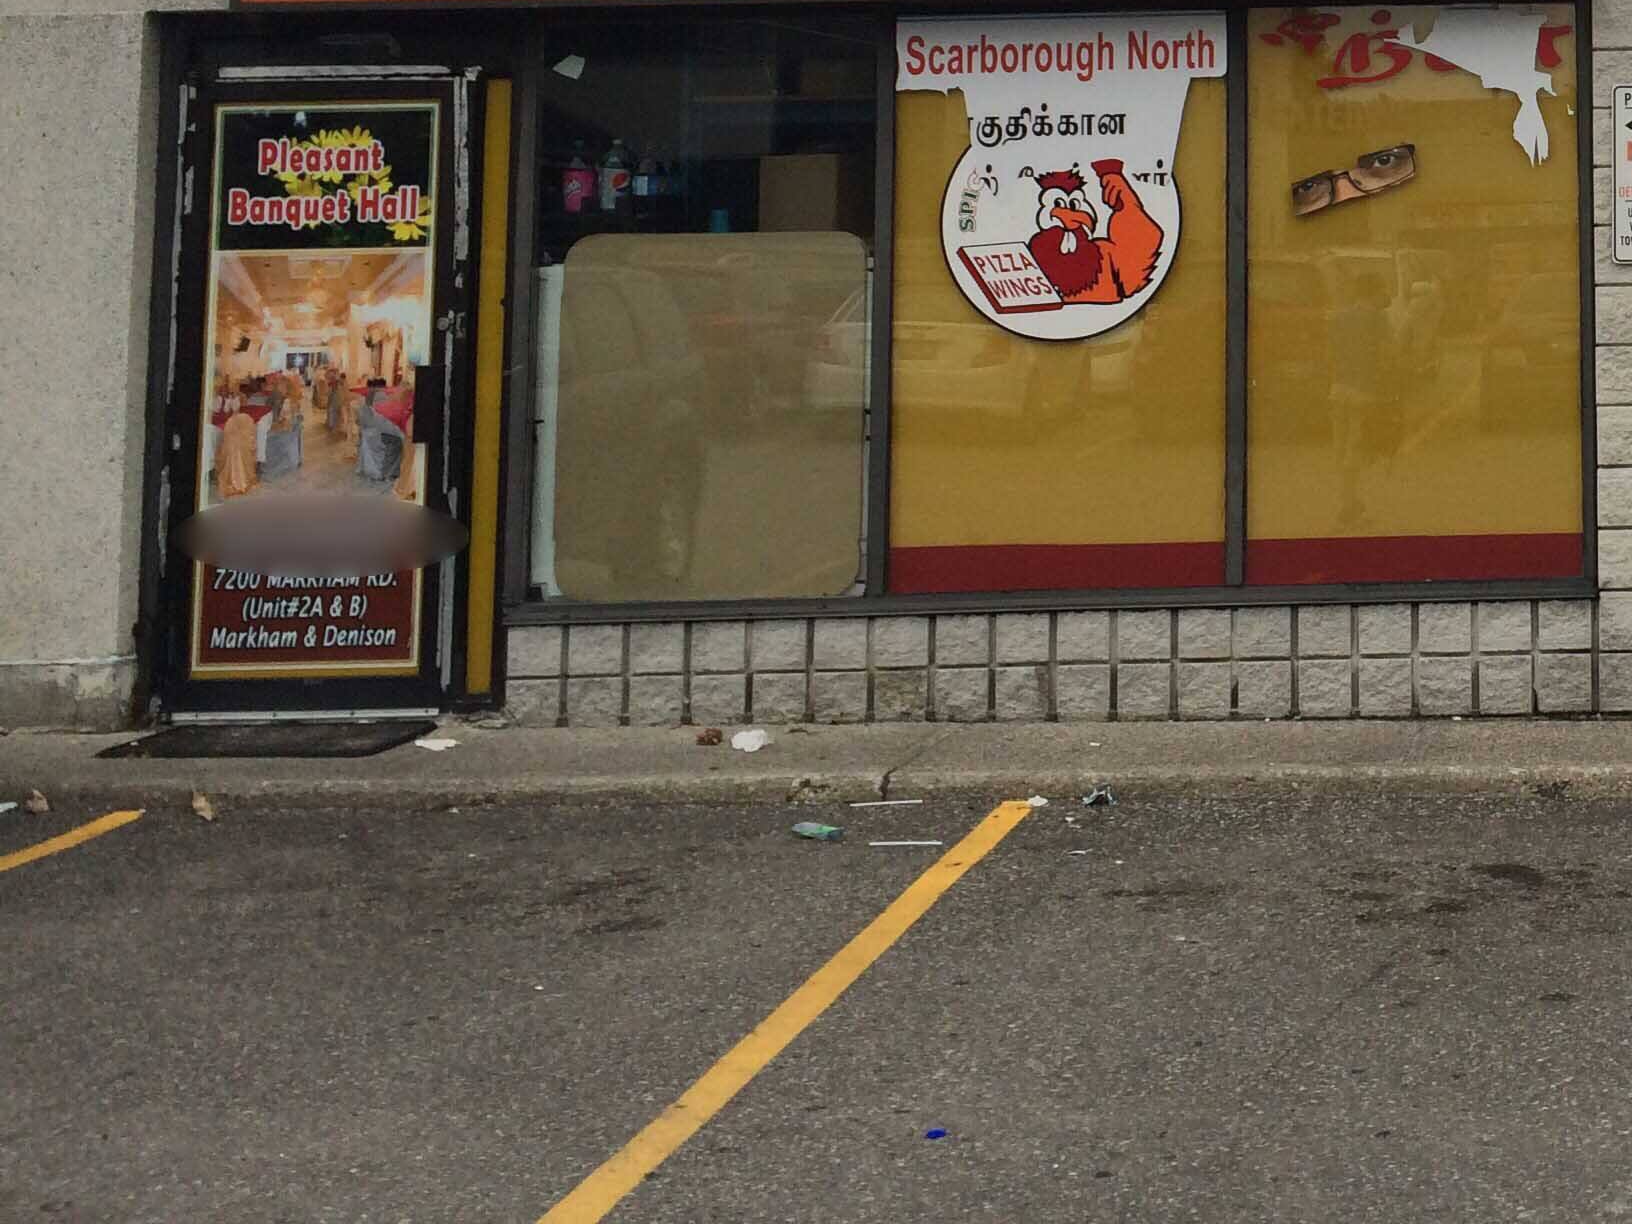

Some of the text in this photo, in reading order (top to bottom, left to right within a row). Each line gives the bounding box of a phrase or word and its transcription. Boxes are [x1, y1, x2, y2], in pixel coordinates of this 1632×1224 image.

[905, 32, 1114, 81] Scarborough
[1127, 30, 1215, 70] North
[258, 139, 384, 175] Pleasant
[228, 186, 420, 229] Banquet Hall
[972, 251, 1037, 275] PIZZA
[987, 275, 1053, 301] WINGS
[242, 594, 368, 622] (Unit#2A & B)
[210, 625, 397, 649] Markham & Denison
